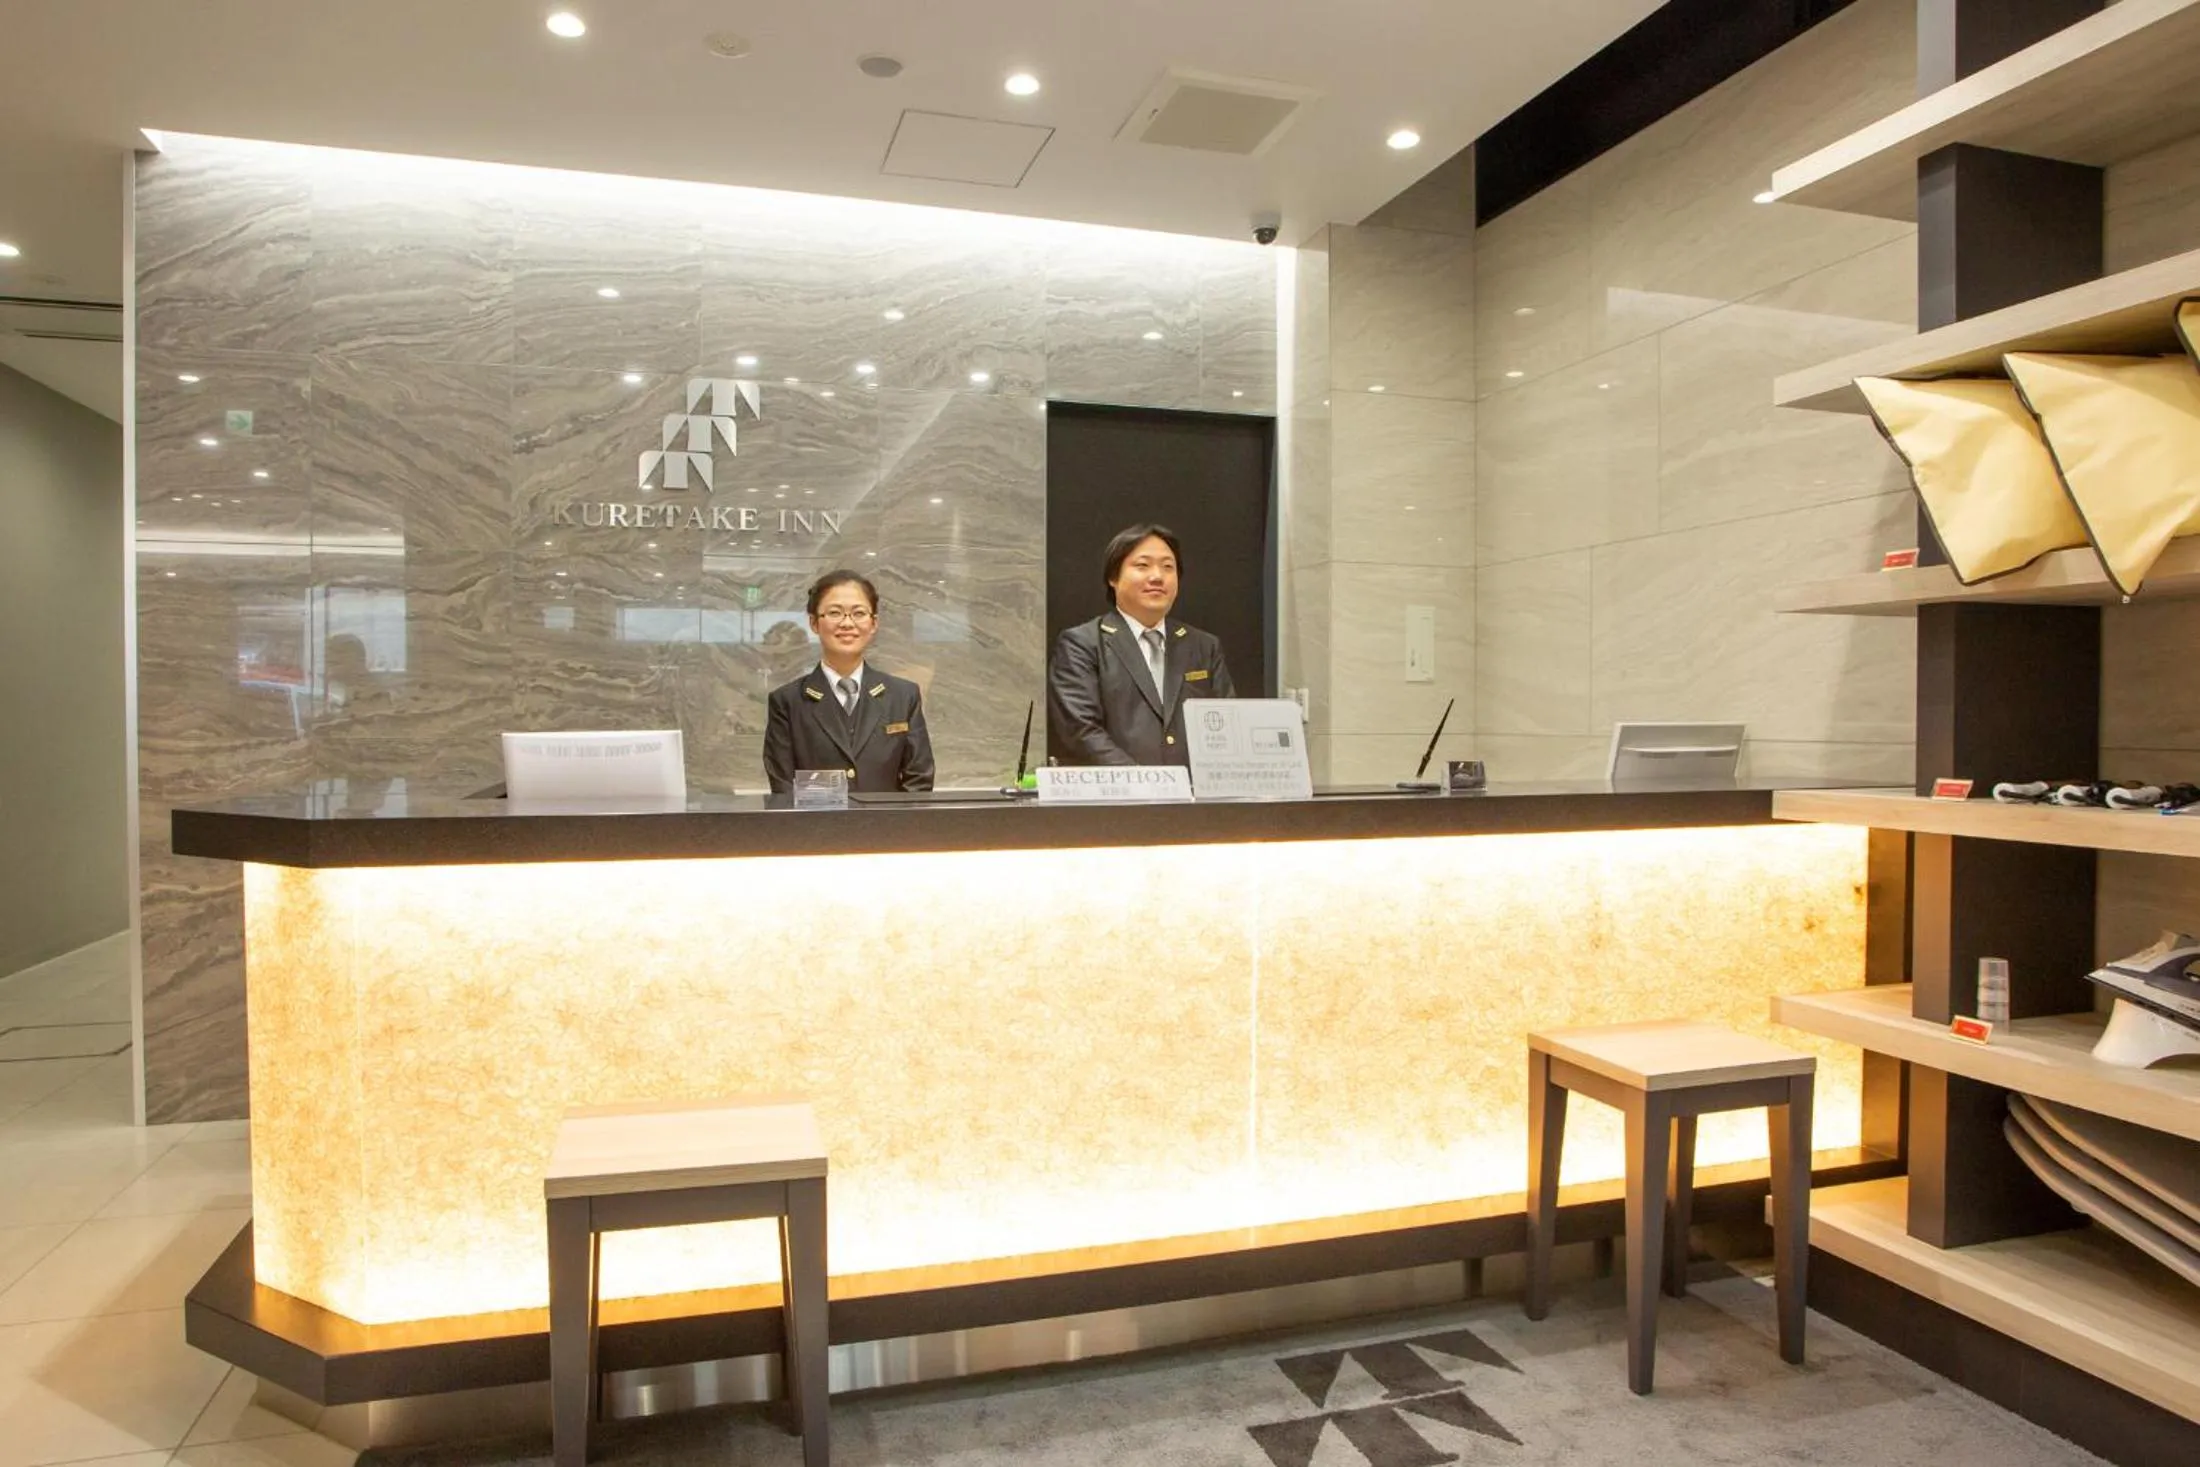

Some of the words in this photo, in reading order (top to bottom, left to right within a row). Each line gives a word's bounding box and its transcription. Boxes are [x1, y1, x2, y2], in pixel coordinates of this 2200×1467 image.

[552, 502, 760, 531] KURETAKE
[776, 508, 841, 534] INN
[1050, 770, 1177, 785] RECEPTION
